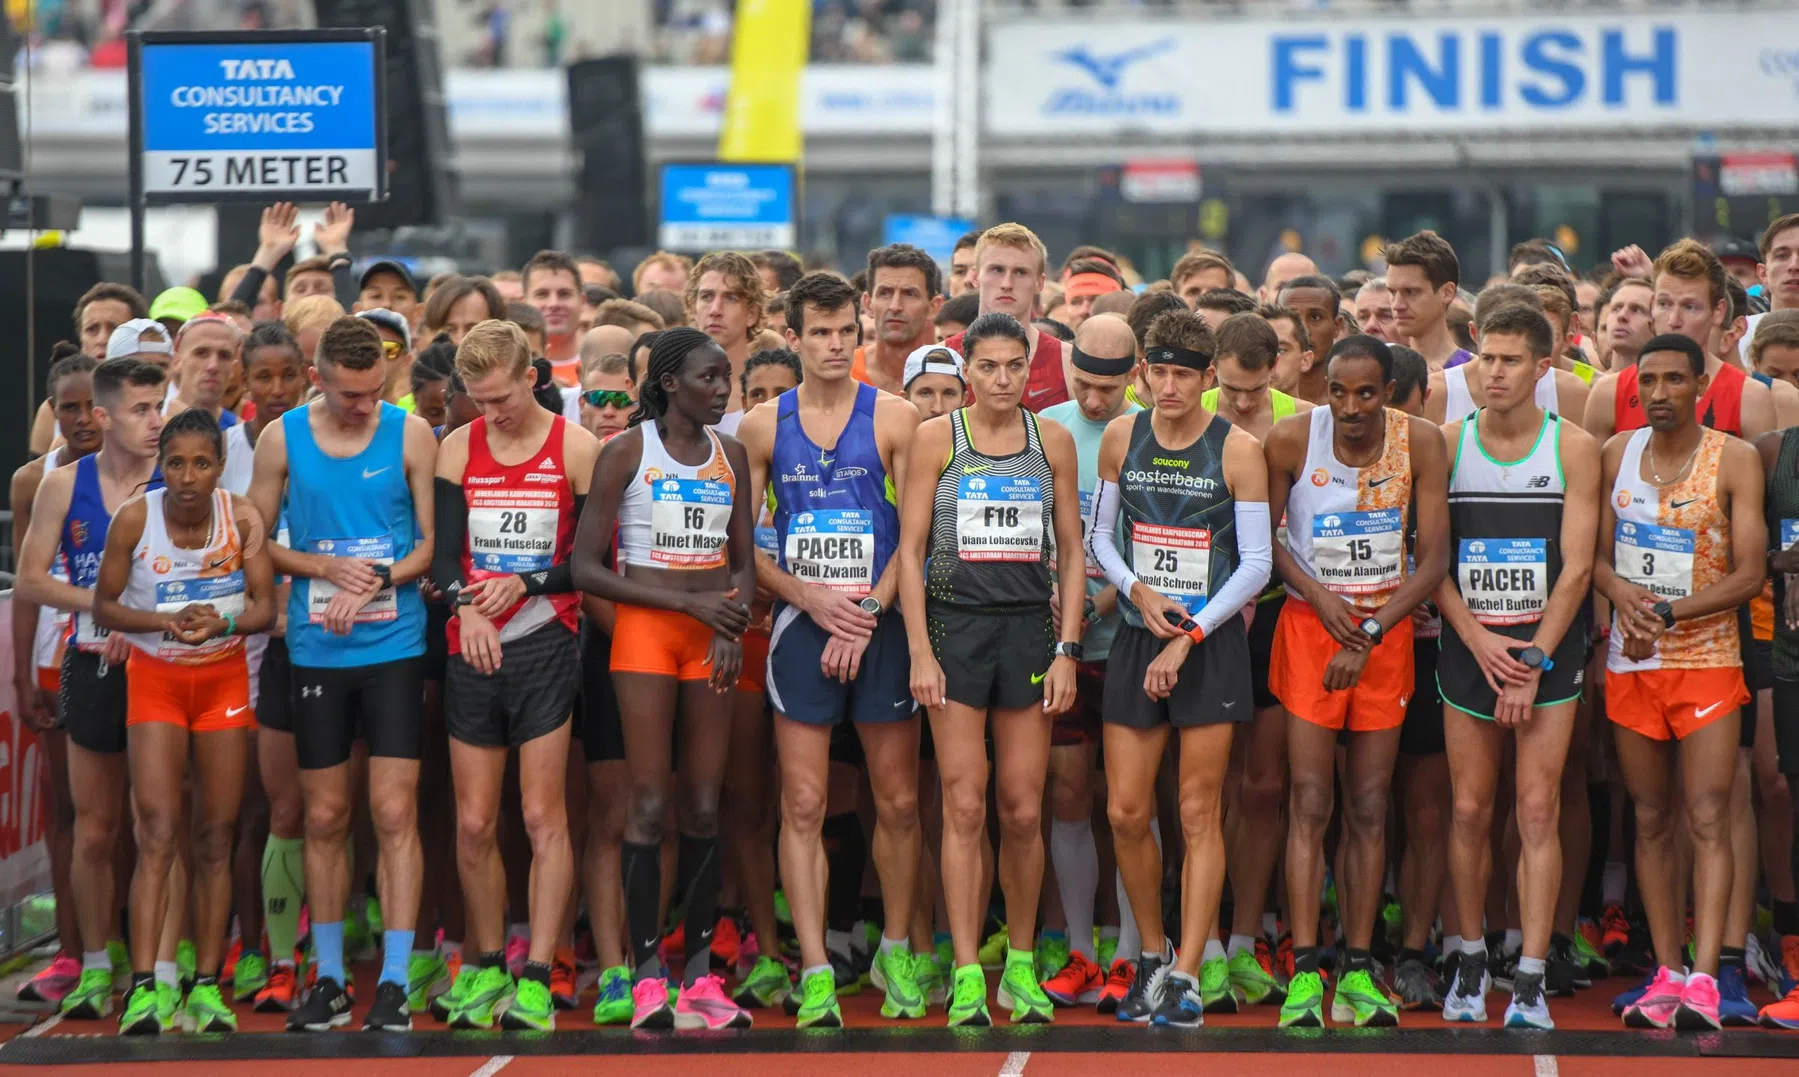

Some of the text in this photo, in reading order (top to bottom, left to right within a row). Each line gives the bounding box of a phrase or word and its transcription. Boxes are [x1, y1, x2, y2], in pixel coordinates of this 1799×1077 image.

[219, 59, 295, 79] TATA
[1270, 26, 1679, 112] FINISH
[171, 85, 344, 107] CONSULTANCY
[204, 111, 314, 134] SERVICES
[170, 156, 348, 185] 75 METER
[1152, 457, 1190, 469] saucony
[782, 474, 819, 483] Brainnet
[835, 469, 862, 478] STAROS
[1127, 470, 1215, 490] oosterbaan
[1332, 476, 1344, 485] NN
[660, 493, 683, 501] TATA
[693, 488, 730, 497] CONSULTANCY
[966, 492, 988, 500] TATA
[1126, 484, 1145, 492] sport-
[1157, 486, 1213, 499] wandelschoenen
[700, 495, 726, 503] SERVICES
[500, 511, 527, 534] 28
[684, 506, 705, 530] F6
[984, 506, 1019, 528] F18
[1355, 516, 1399, 527] CONSULTANCY
[794, 525, 817, 533] TATA
[836, 525, 864, 533] SERVICES
[1320, 529, 1344, 537] TATA
[1364, 525, 1392, 533] SERVICES
[1661, 528, 1681, 536] TATA
[474, 536, 552, 550] Frank Futselaar
[656, 532, 690, 549] Linet
[962, 535, 1039, 547] Diana Lobacevske
[1619, 536, 1638, 545] TATA
[1648, 534, 1693, 544] CONSULTANCY
[347, 543, 391, 553] CONSULTANCY
[797, 537, 863, 560] PACER
[1346, 538, 1372, 561] 15
[1498, 547, 1544, 555] CONSULTANCY
[1655, 542, 1684, 551] SERVICES
[1154, 548, 1178, 573] 25
[1642, 553, 1655, 576] 3
[792, 562, 867, 579] Paul Zwama
[1320, 565, 1352, 577] Yenew
[1354, 563, 1397, 577] Alamirew
[1163, 575, 1203, 590] Schroer
[1469, 568, 1536, 592] PACER
[1650, 584, 1686, 596] Deksisa
[164, 594, 189, 602] TATA
[1467, 597, 1543, 611] Michel Butter
